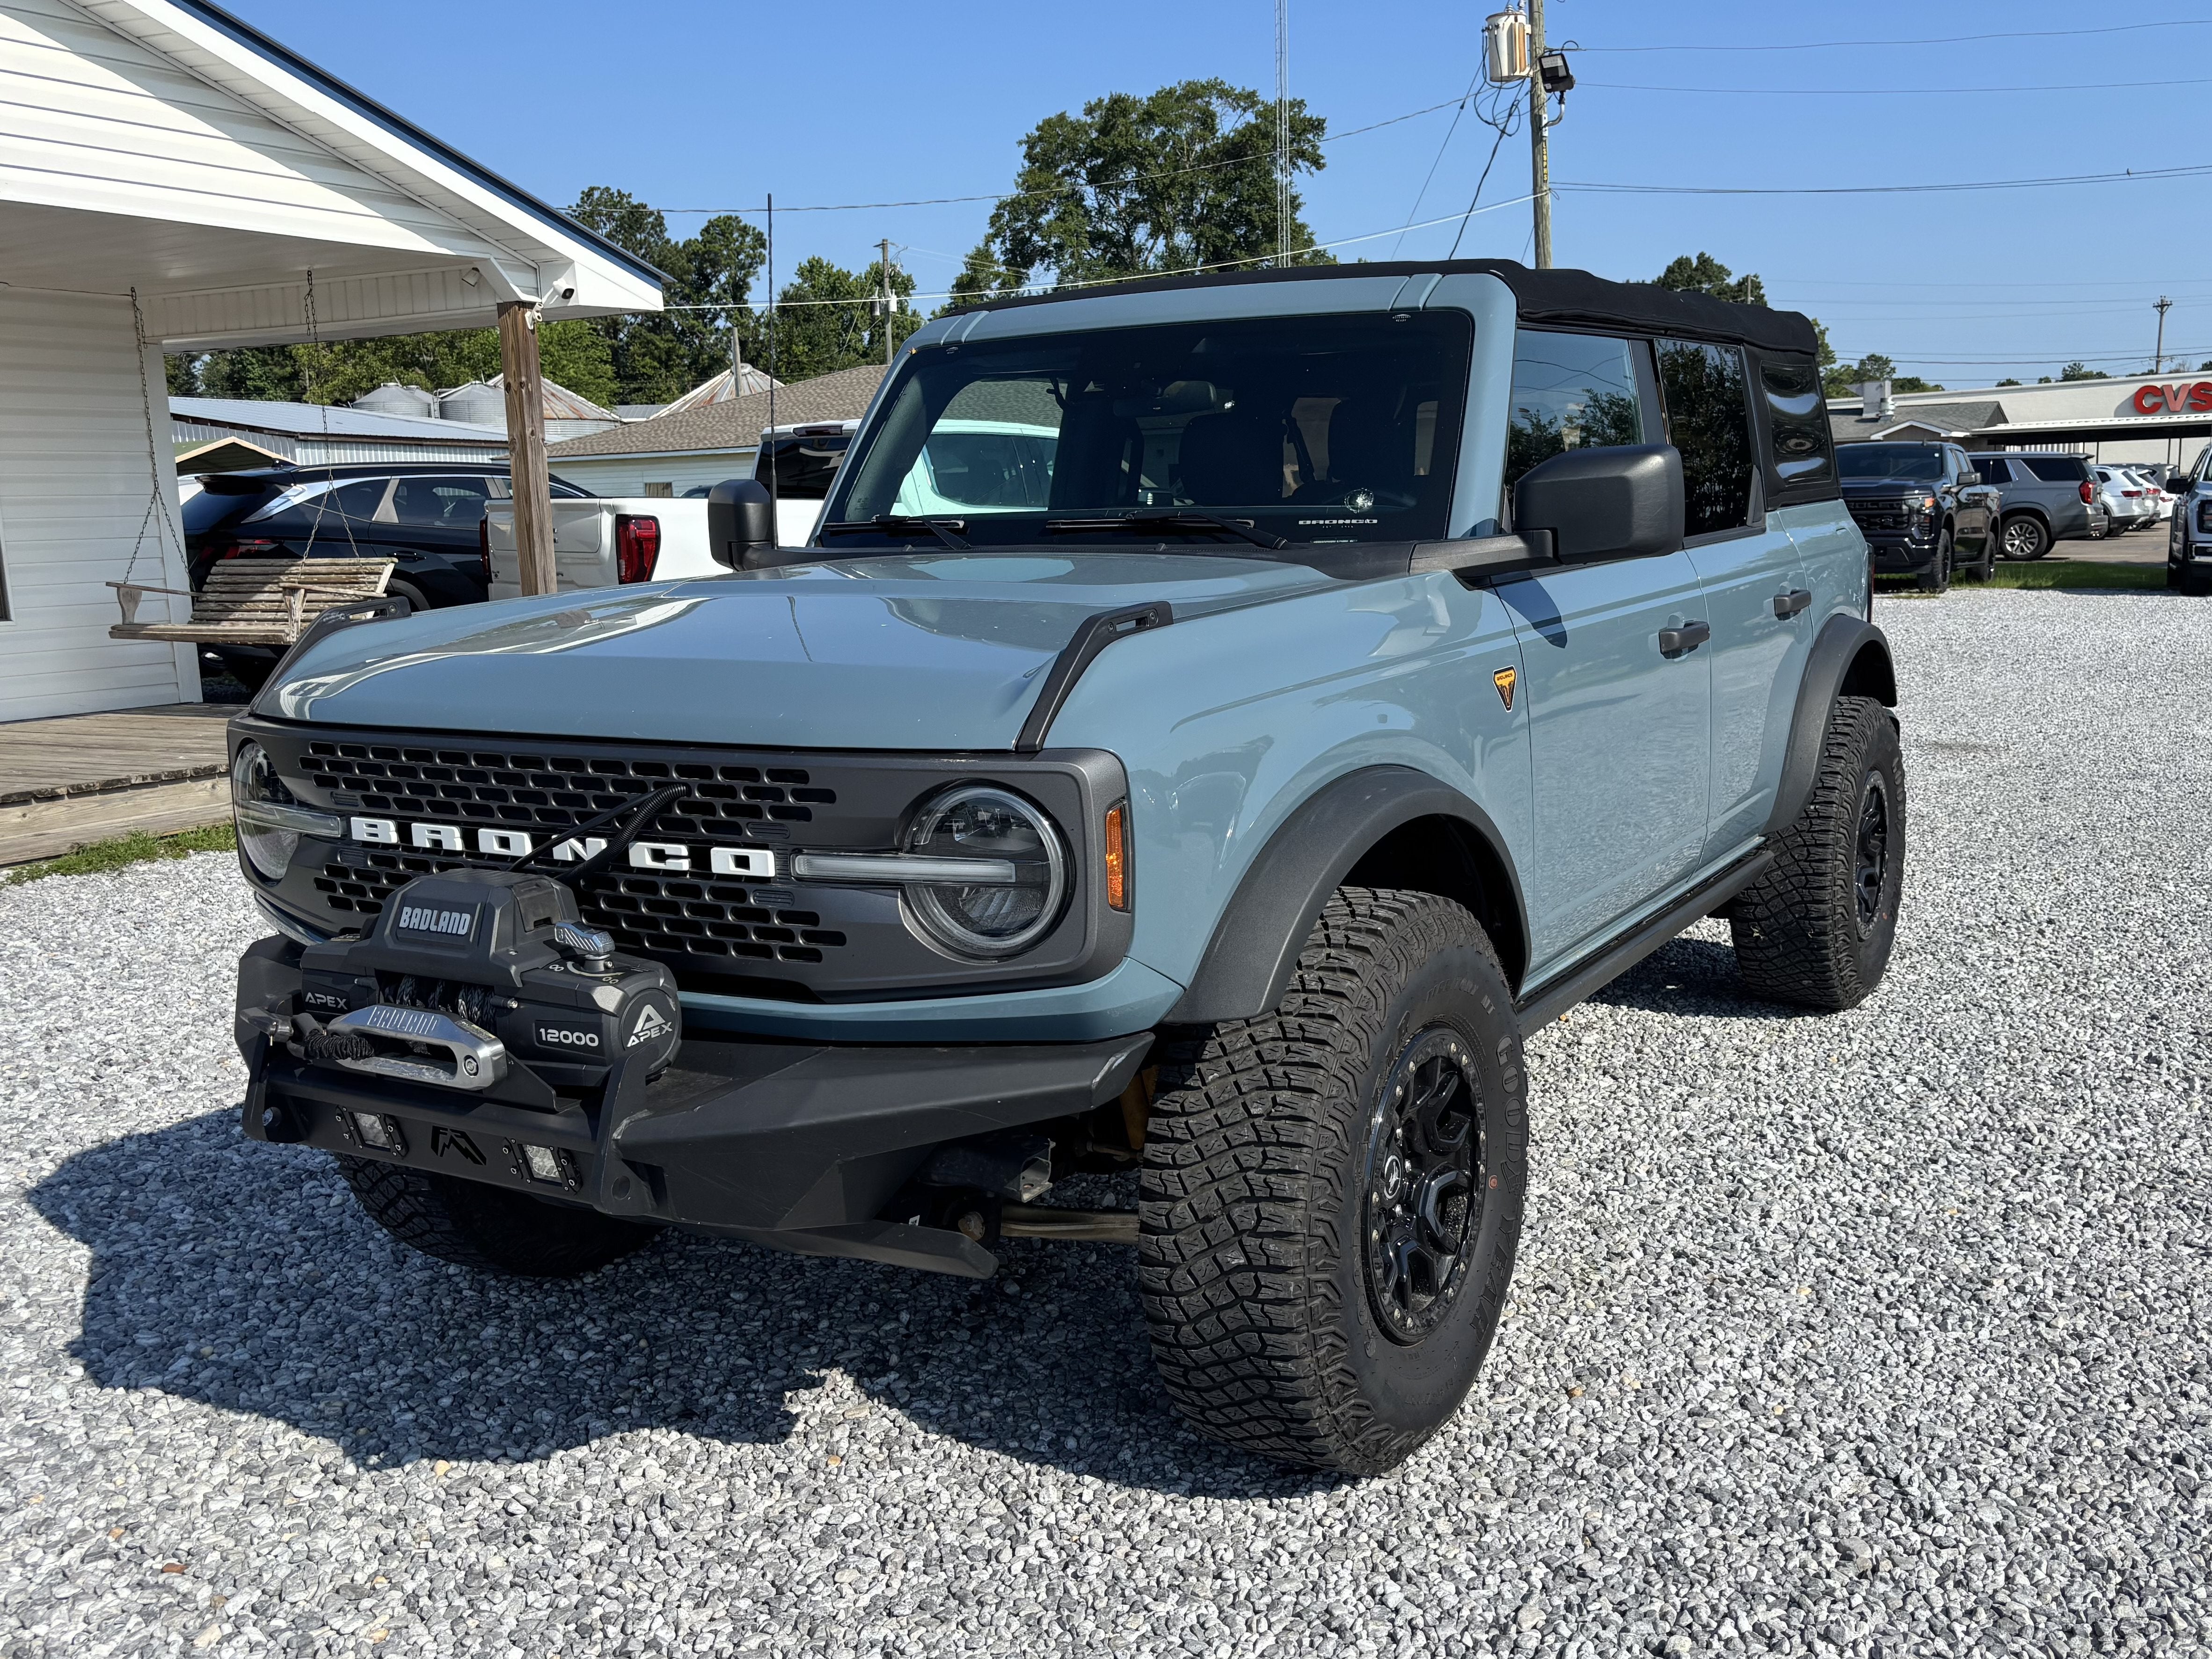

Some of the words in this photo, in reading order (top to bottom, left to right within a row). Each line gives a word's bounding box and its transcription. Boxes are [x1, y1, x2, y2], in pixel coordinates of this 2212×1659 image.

[2134, 382, 2212, 414] CVS
[350, 817, 775, 877] BRONCO
[399, 906, 471, 935] BADLAND
[305, 992, 348, 1010] APEX
[540, 1028, 599, 1047] 12000
[627, 1022, 673, 1047] APEX
